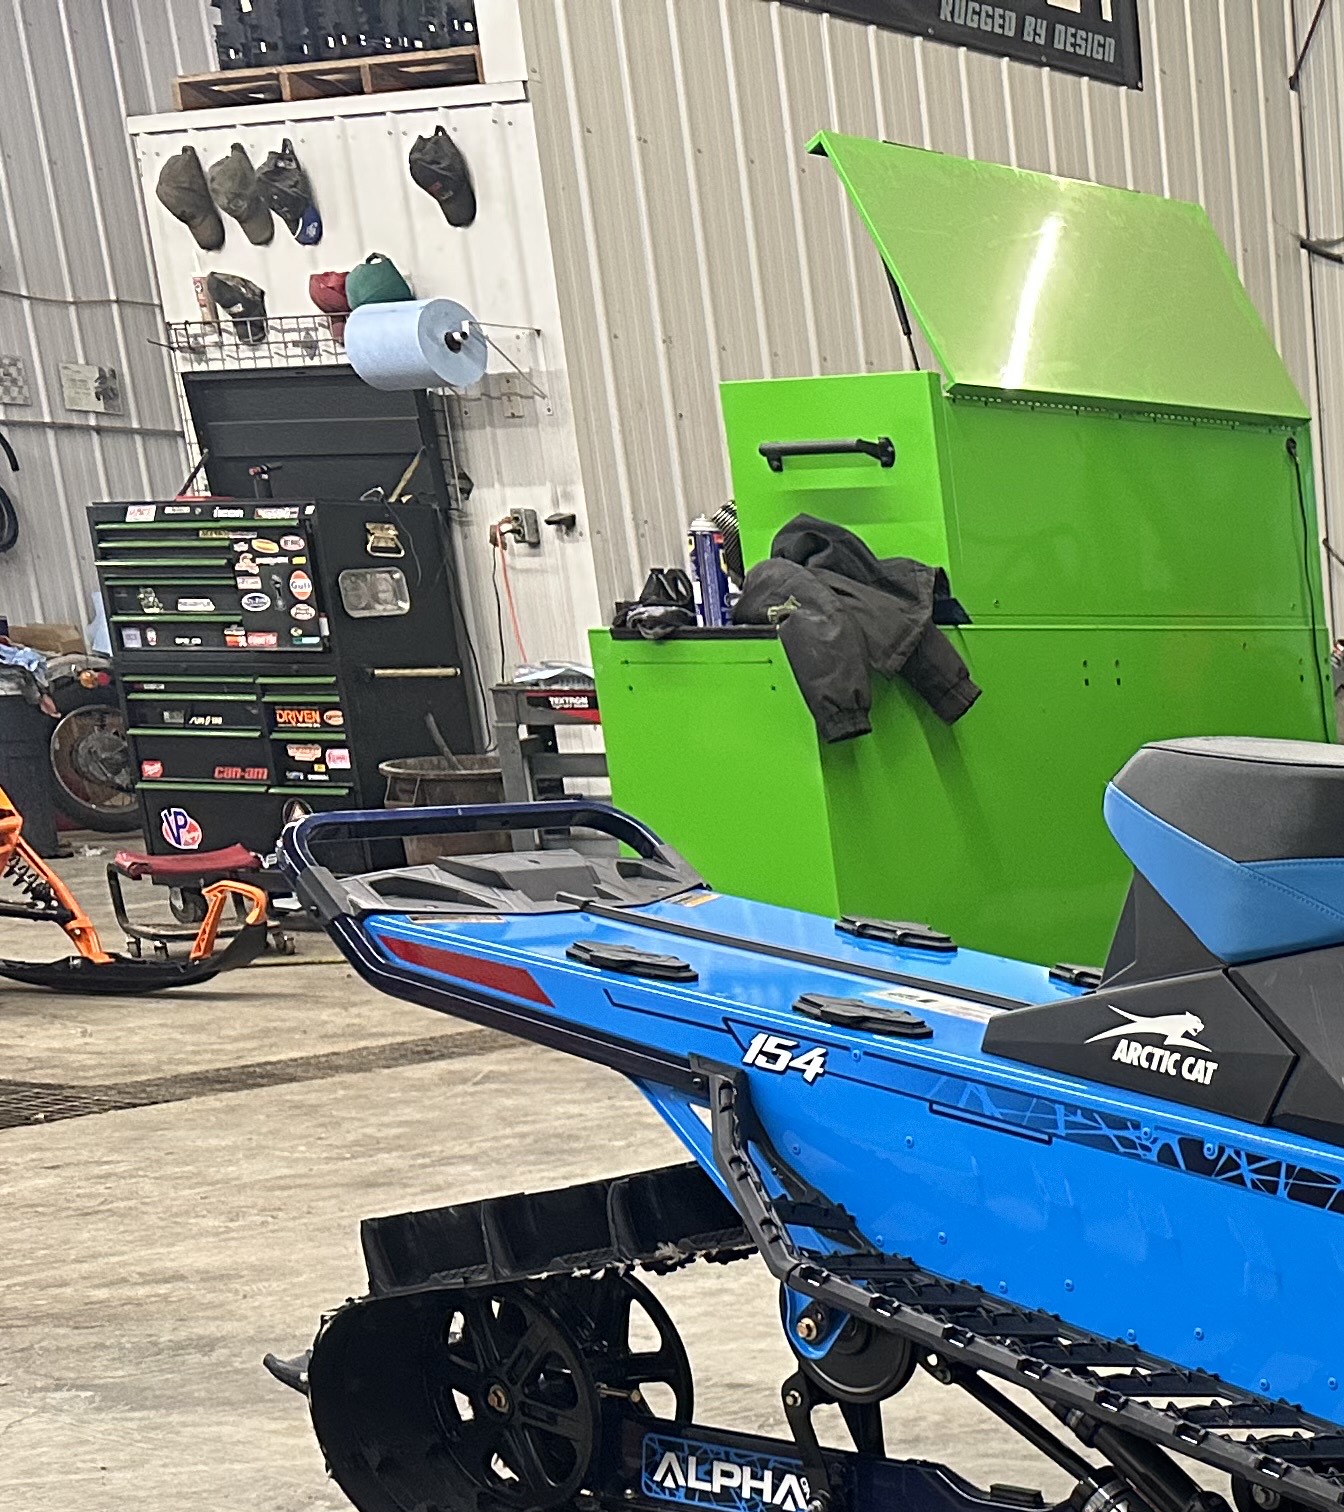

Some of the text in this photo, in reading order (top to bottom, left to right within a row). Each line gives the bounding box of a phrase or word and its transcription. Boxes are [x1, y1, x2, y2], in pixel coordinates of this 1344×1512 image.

[939, 0, 1116, 63] RUGGED BY DESIGN
[275, 709, 321, 724] DRIVEN
[214, 766, 268, 780] can-am
[742, 1031, 829, 1083] 154
[1111, 1038, 1219, 1086] ARCTIC CAT
[652, 1452, 809, 1512] ALPHA
